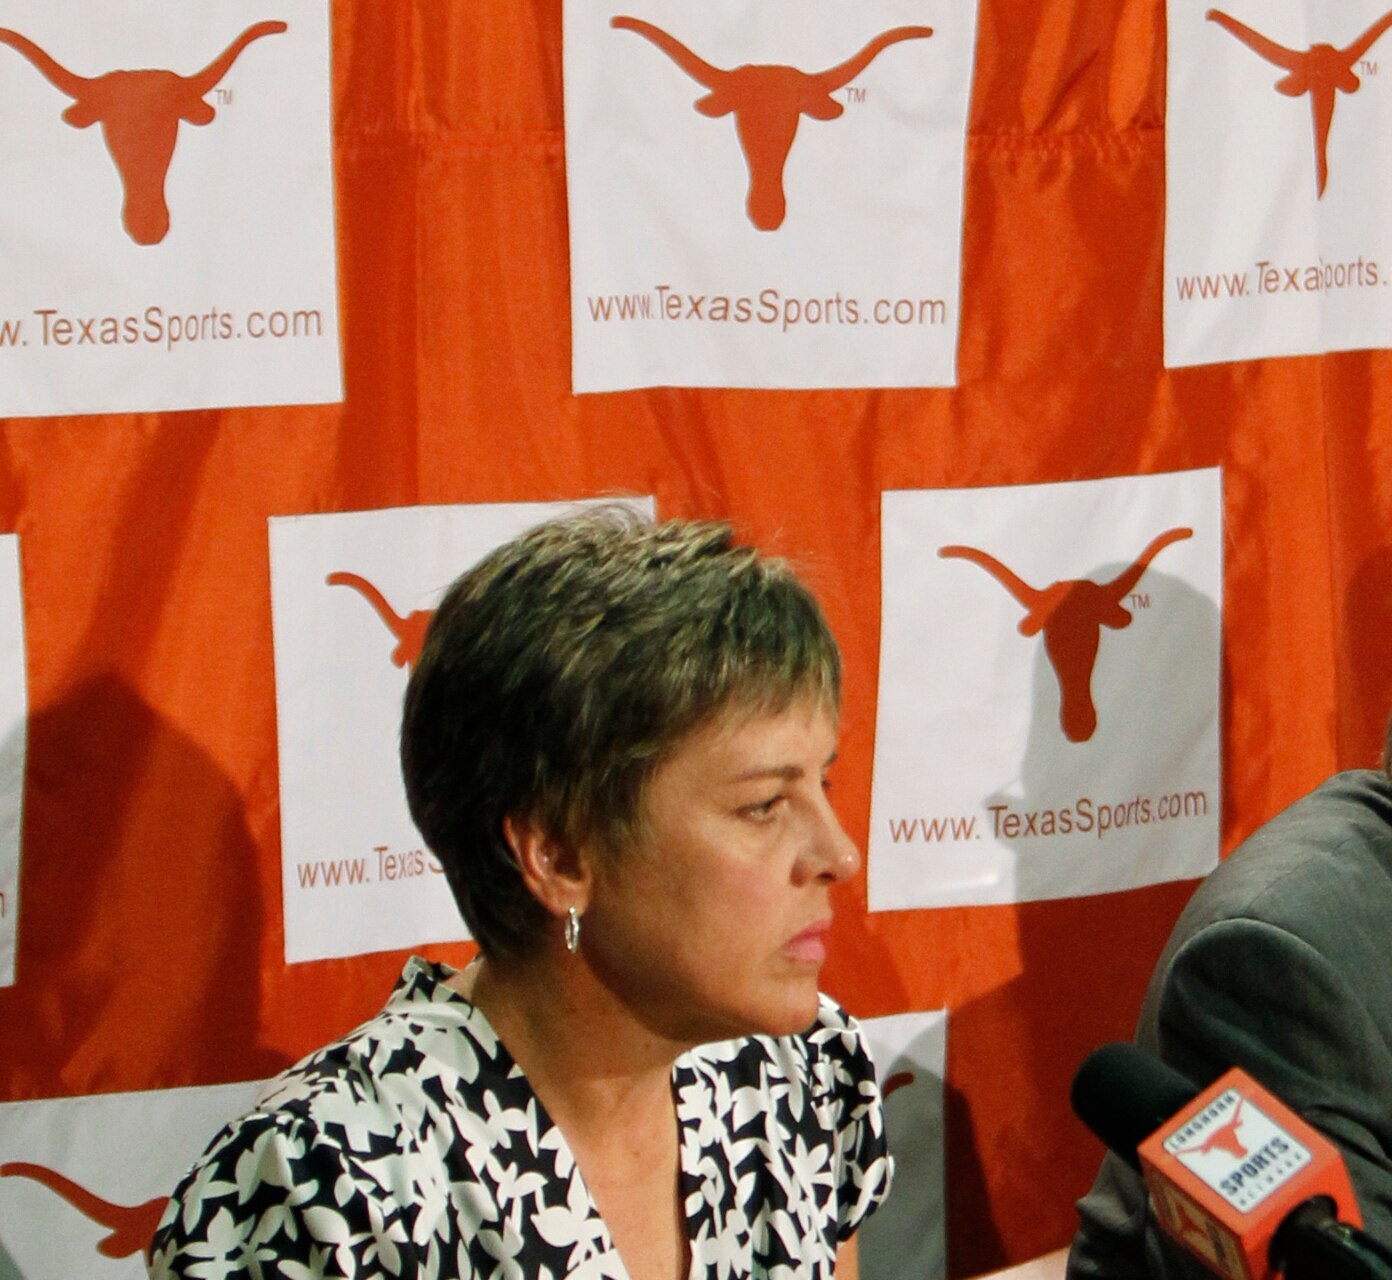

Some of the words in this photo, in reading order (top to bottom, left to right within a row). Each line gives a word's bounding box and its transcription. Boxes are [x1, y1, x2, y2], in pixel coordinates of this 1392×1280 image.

[587, 284, 946, 332] www.TexasSports.com
[889, 789, 1207, 843] www.TexasSports.com
[1220, 1136, 1289, 1195] SPORTS
